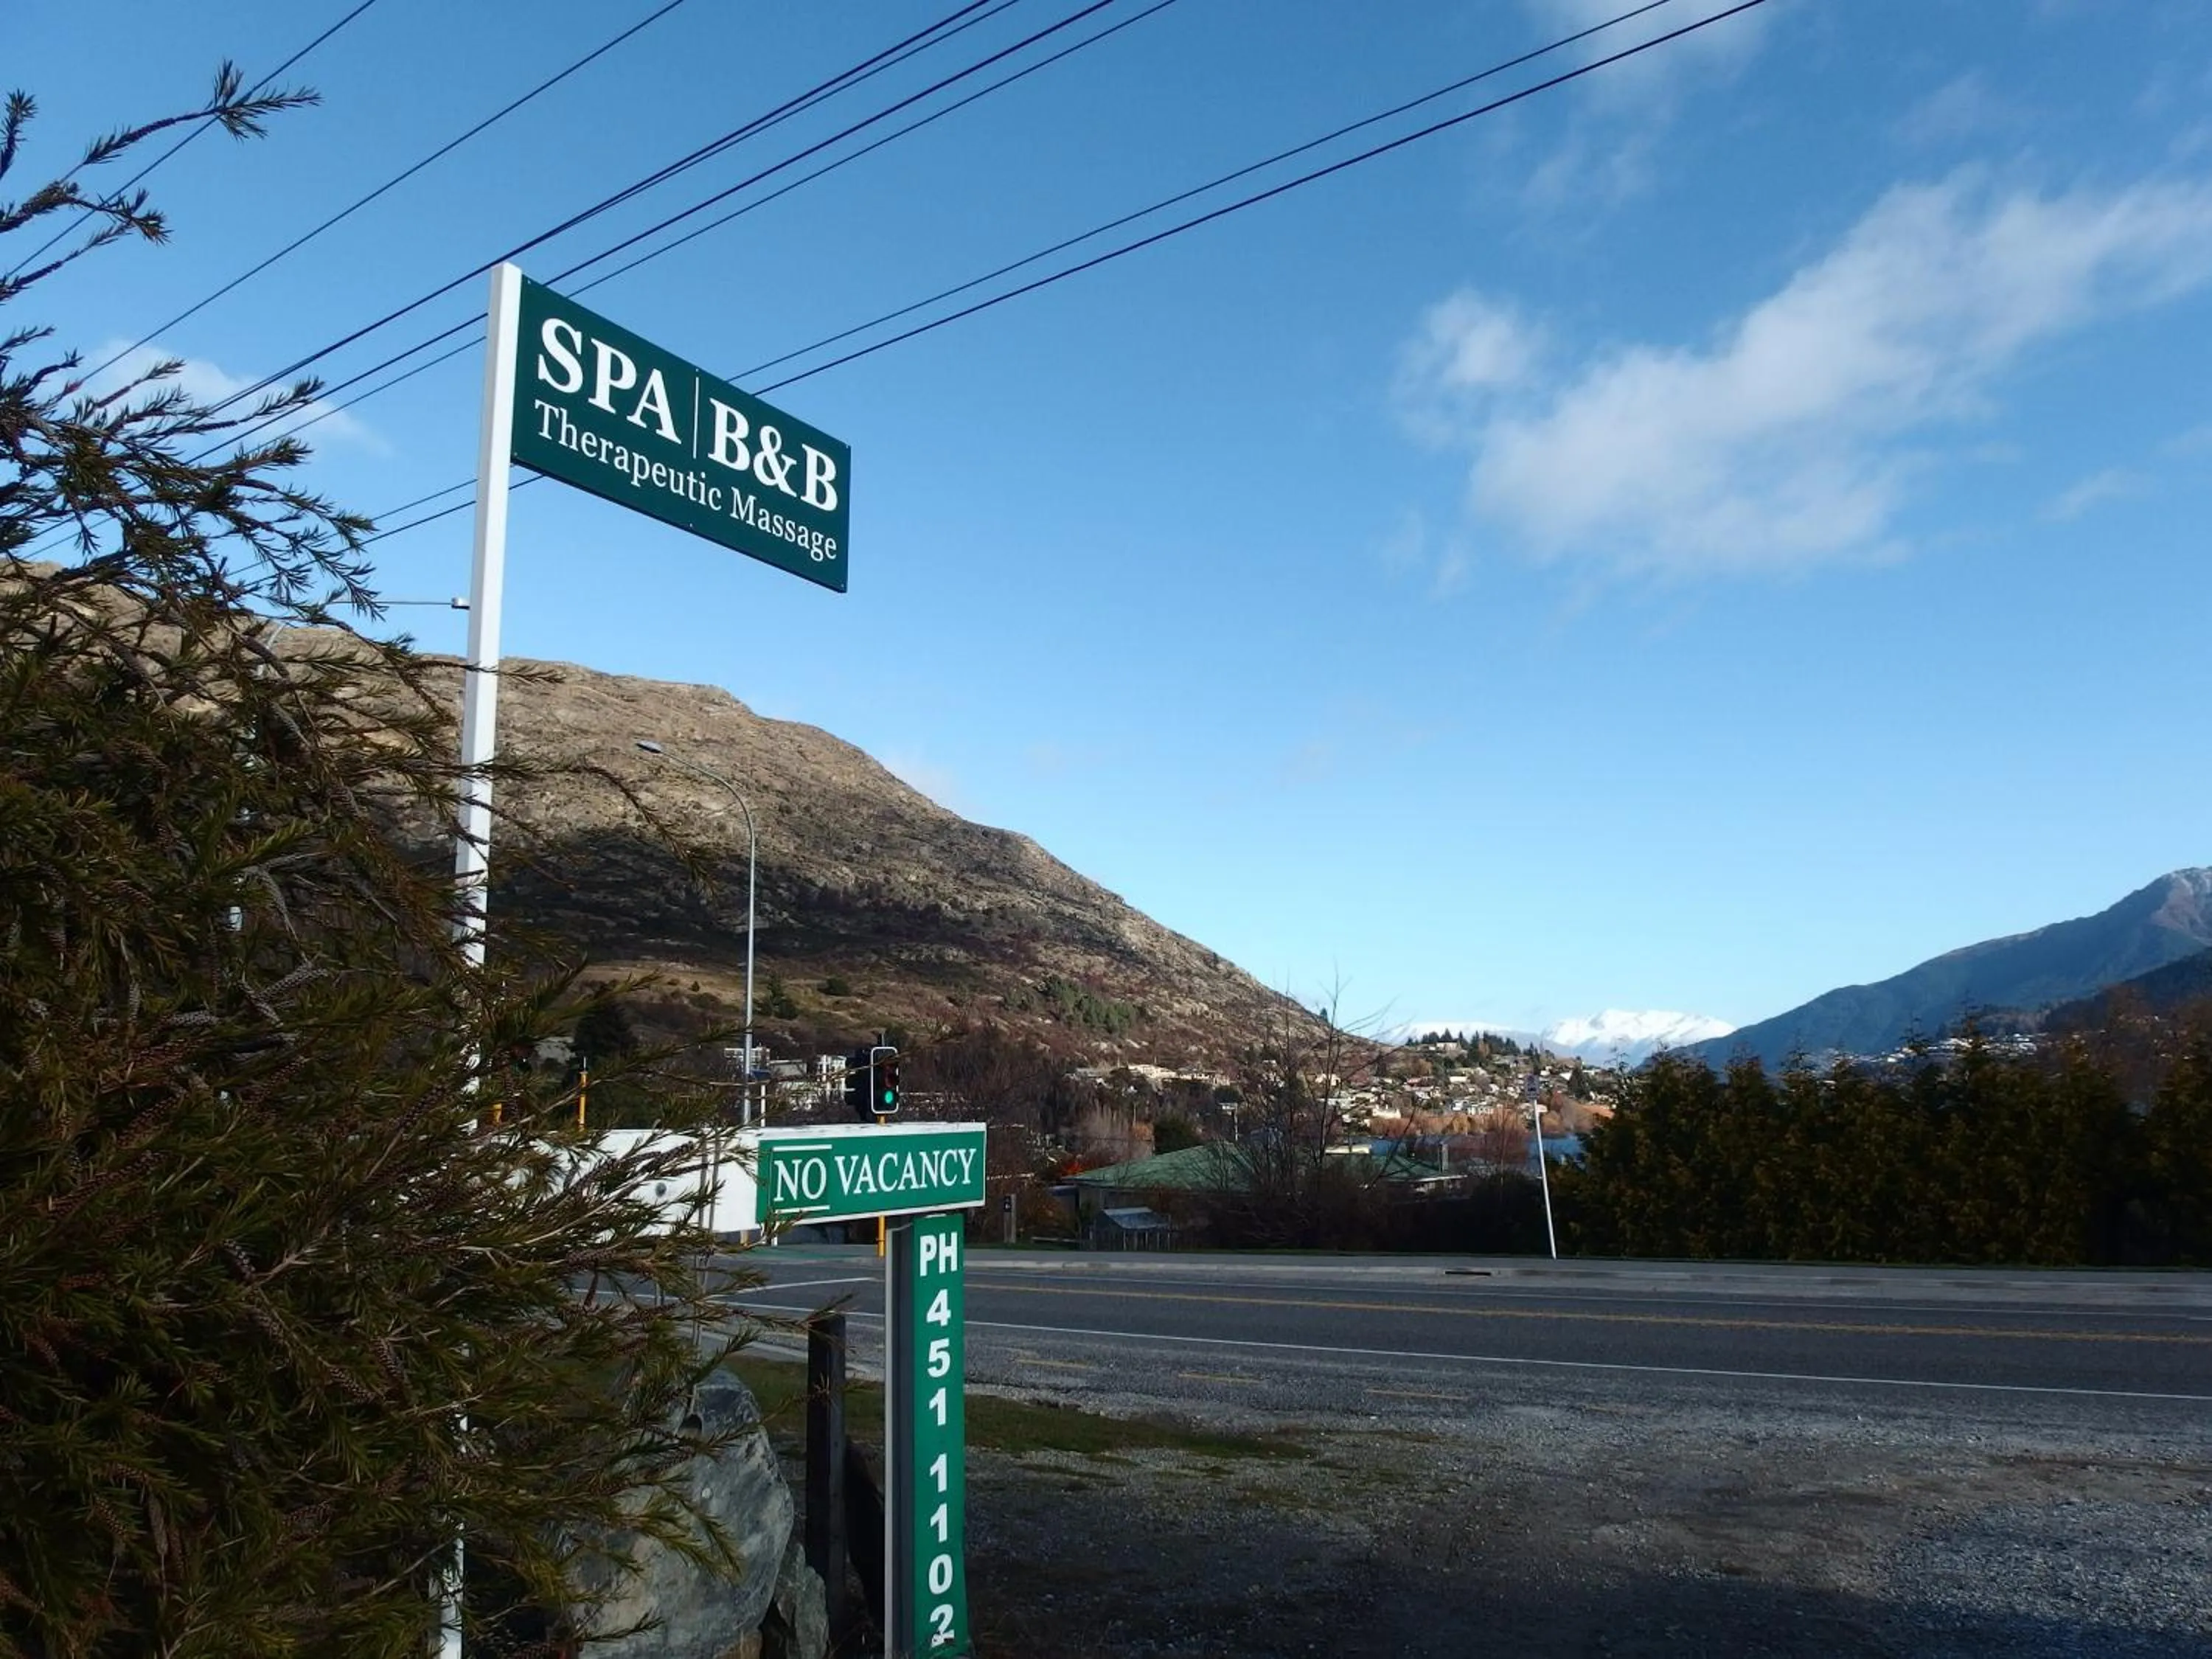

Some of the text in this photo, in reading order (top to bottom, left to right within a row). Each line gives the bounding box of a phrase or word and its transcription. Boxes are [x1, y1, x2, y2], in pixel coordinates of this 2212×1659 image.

[535, 399, 837, 562] Therapeutic Massage
[538, 318, 838, 511] SPA B&B
[773, 1148, 977, 1202] NO VACANCY
[919, 1231, 958, 1276] PH
[926, 1289, 955, 1648] 451 1102
